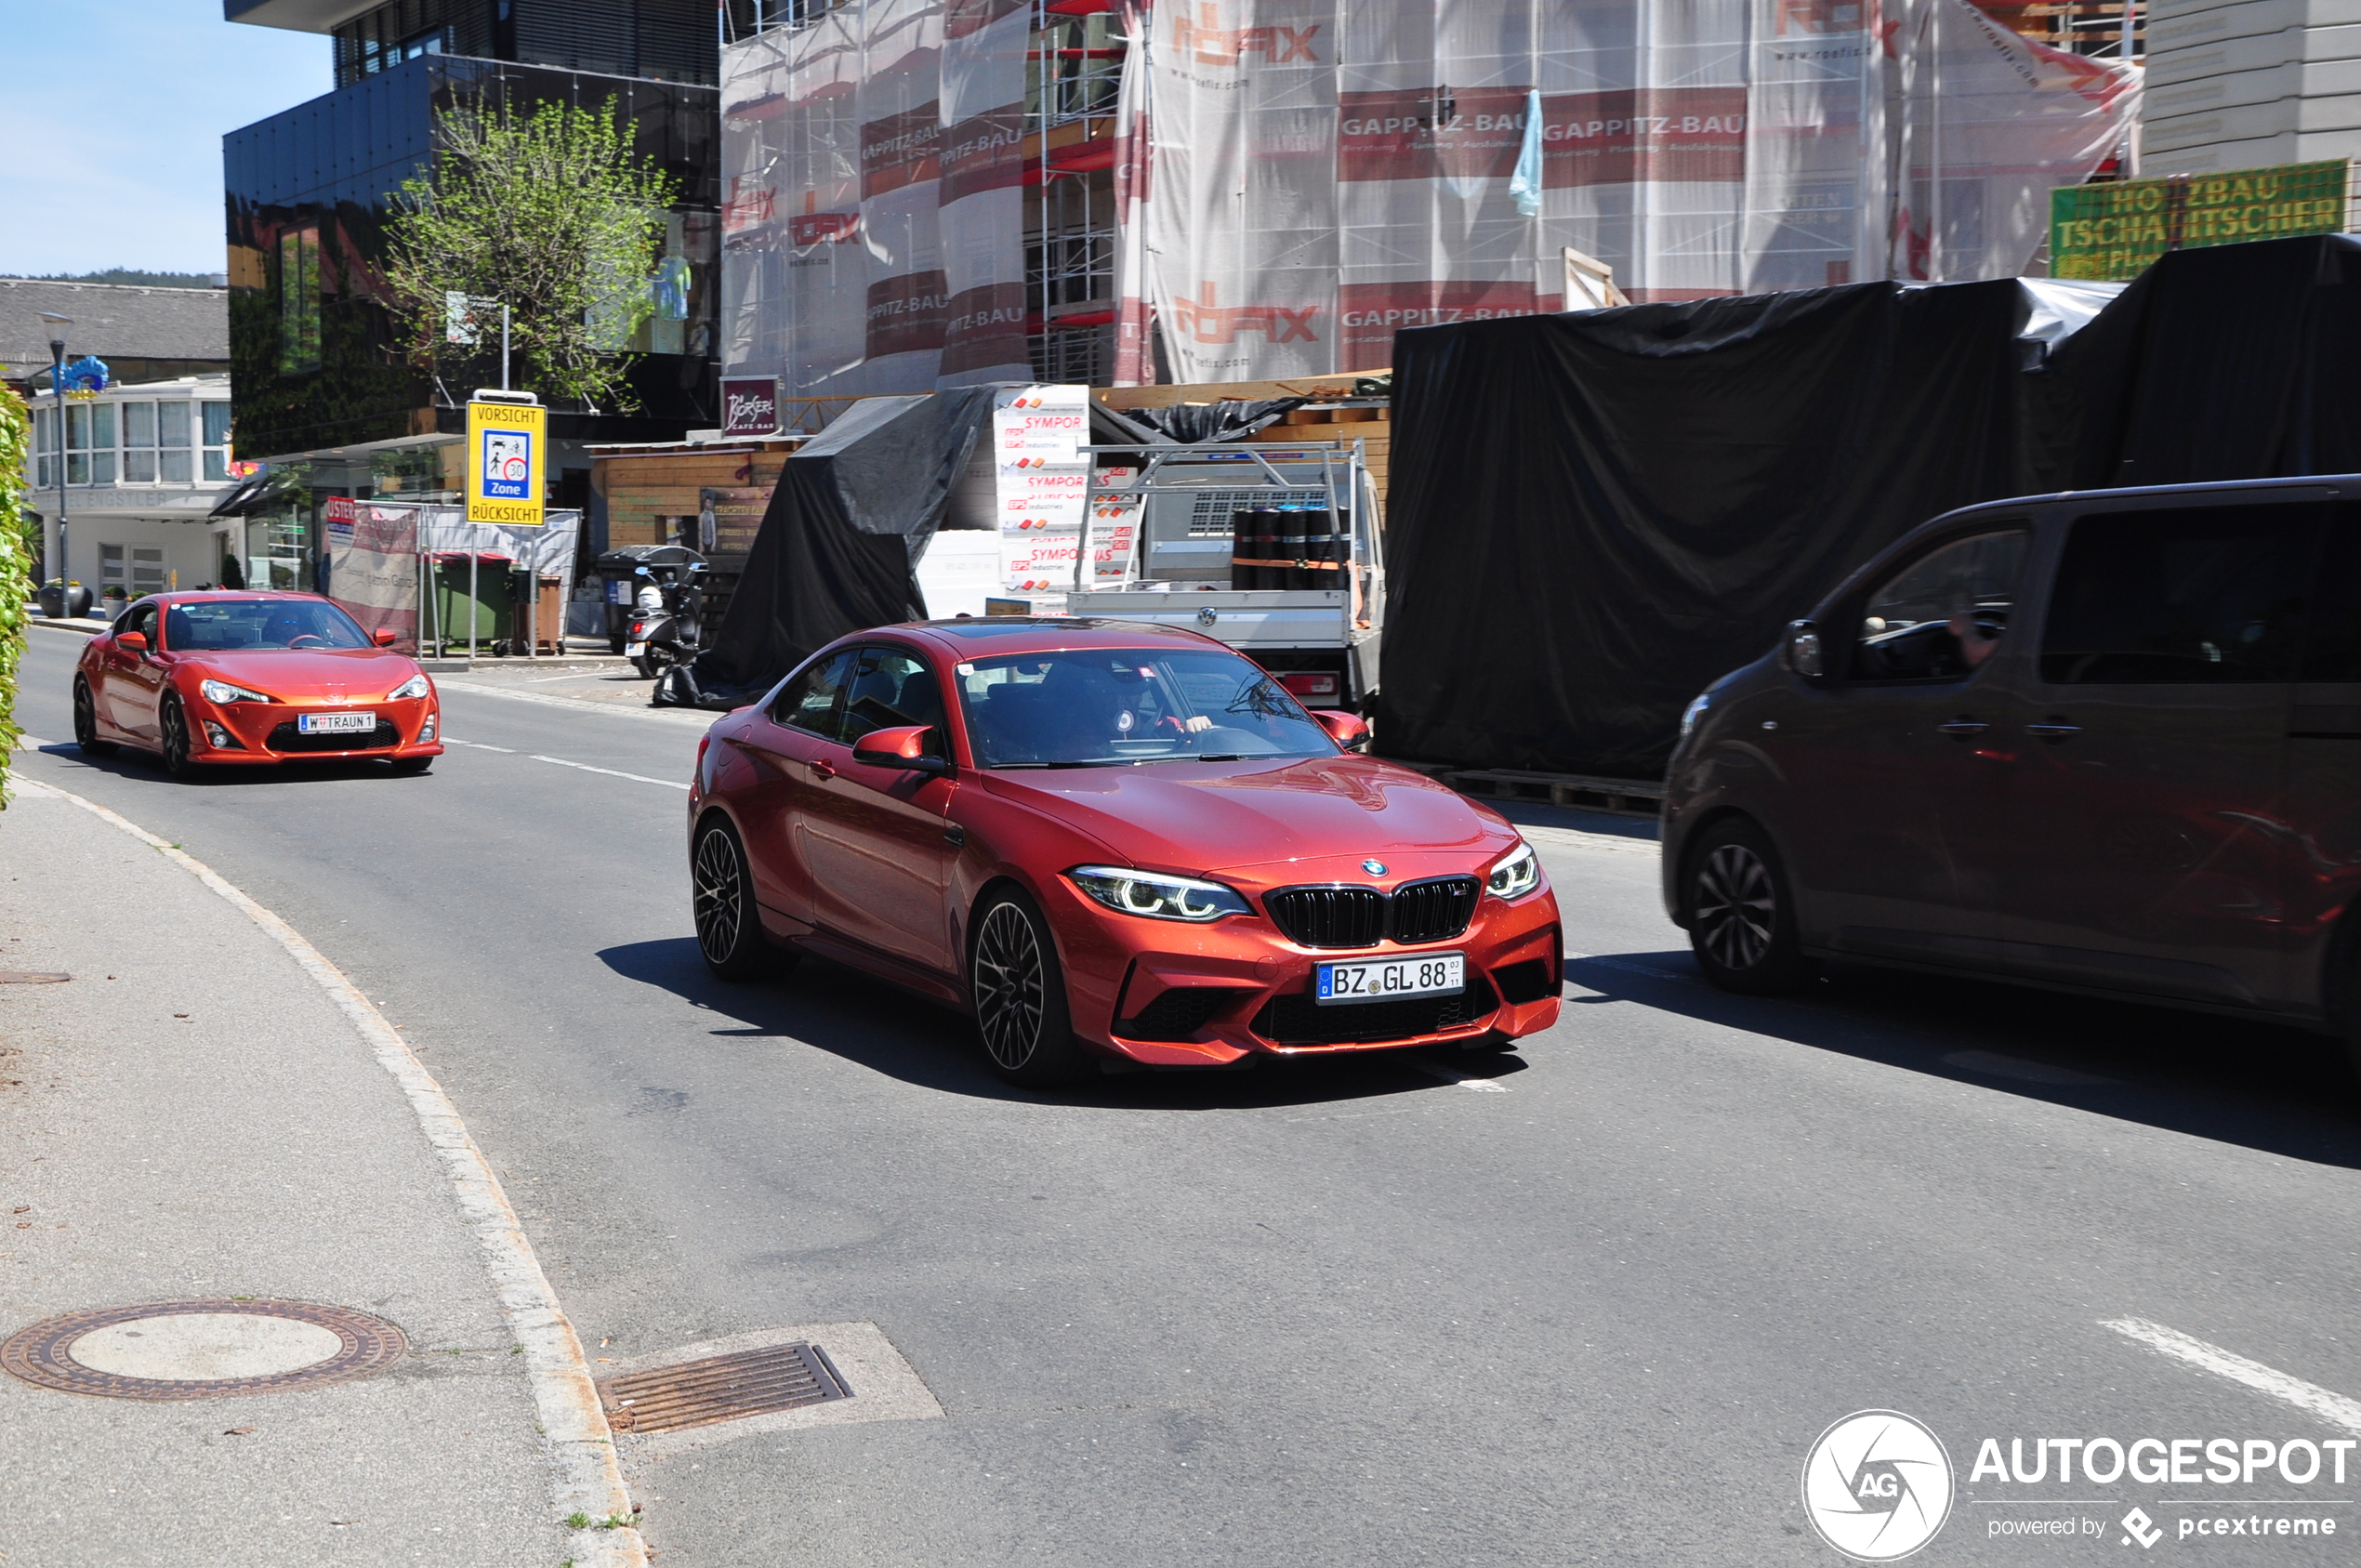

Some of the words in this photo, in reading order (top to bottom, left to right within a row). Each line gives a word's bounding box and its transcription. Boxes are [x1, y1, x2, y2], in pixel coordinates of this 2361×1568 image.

[1543, 115, 1746, 141] GAPPITZ-BAU
[2112, 177, 2278, 213] HOZBAU
[2057, 197, 2338, 247] TSCHAITSCHER
[477, 407, 536, 423] VORSICHT
[1025, 417, 1081, 428] SYMPOR
[509, 464, 523, 477] 30
[491, 482, 521, 495] Zone
[1028, 477, 1085, 487] SYMPOR
[87, 493, 167, 507] ENGSTLER
[472, 503, 538, 521] RÜCKSICHT
[310, 718, 319, 729] W
[328, 716, 364, 728] TRAUN
[366, 716, 371, 727] 1
[1450, 960, 1459, 968] 03
[1334, 968, 1366, 995] BZ
[1383, 965, 1414, 992] GL
[1418, 962, 1445, 989] 88
[1450, 978, 1459, 986] 11
